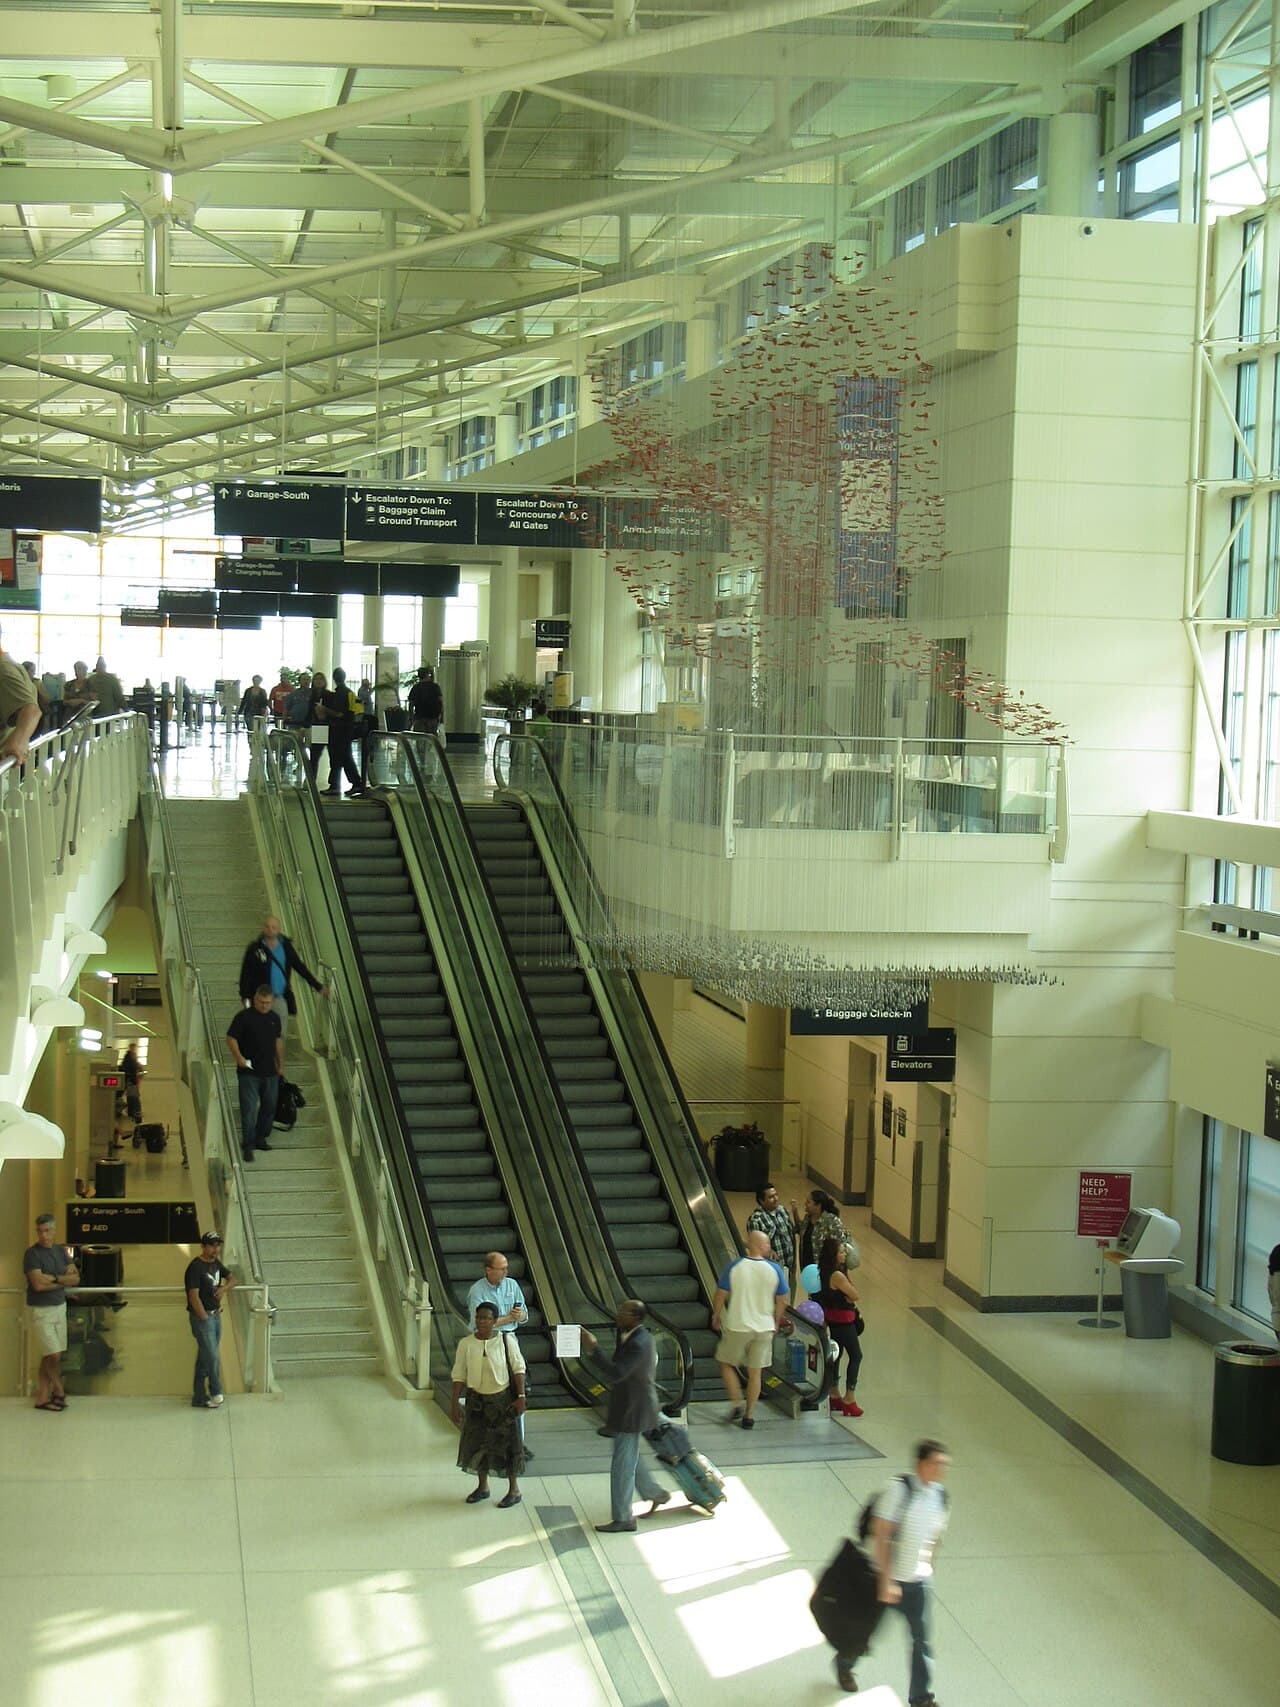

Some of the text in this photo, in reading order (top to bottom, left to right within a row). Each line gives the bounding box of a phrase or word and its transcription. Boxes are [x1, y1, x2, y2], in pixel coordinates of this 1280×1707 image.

[246, 489, 310, 500] Garage-South
[366, 494, 452, 505] Escalator Down To:
[496, 499, 538, 508] Escalator
[379, 505, 446, 516] Baggage Claim
[509, 510, 557, 520] Concourse
[581, 512, 589, 520] C
[379, 516, 458, 528] Ground Transport
[509, 521, 549, 530] All Gates
[622, 525, 652, 534] Anim
[680, 527, 700, 536] Aea
[825, 1009, 912, 1020] Baggage Check-in
[891, 1060, 933, 1070] Elevators
[1081, 1178, 1106, 1187] NEED
[1081, 1187, 1109, 1196] HELP?
[92, 1207, 118, 1216] Garage
[124, 1207, 145, 1215] South
[92, 1224, 109, 1232] AED
